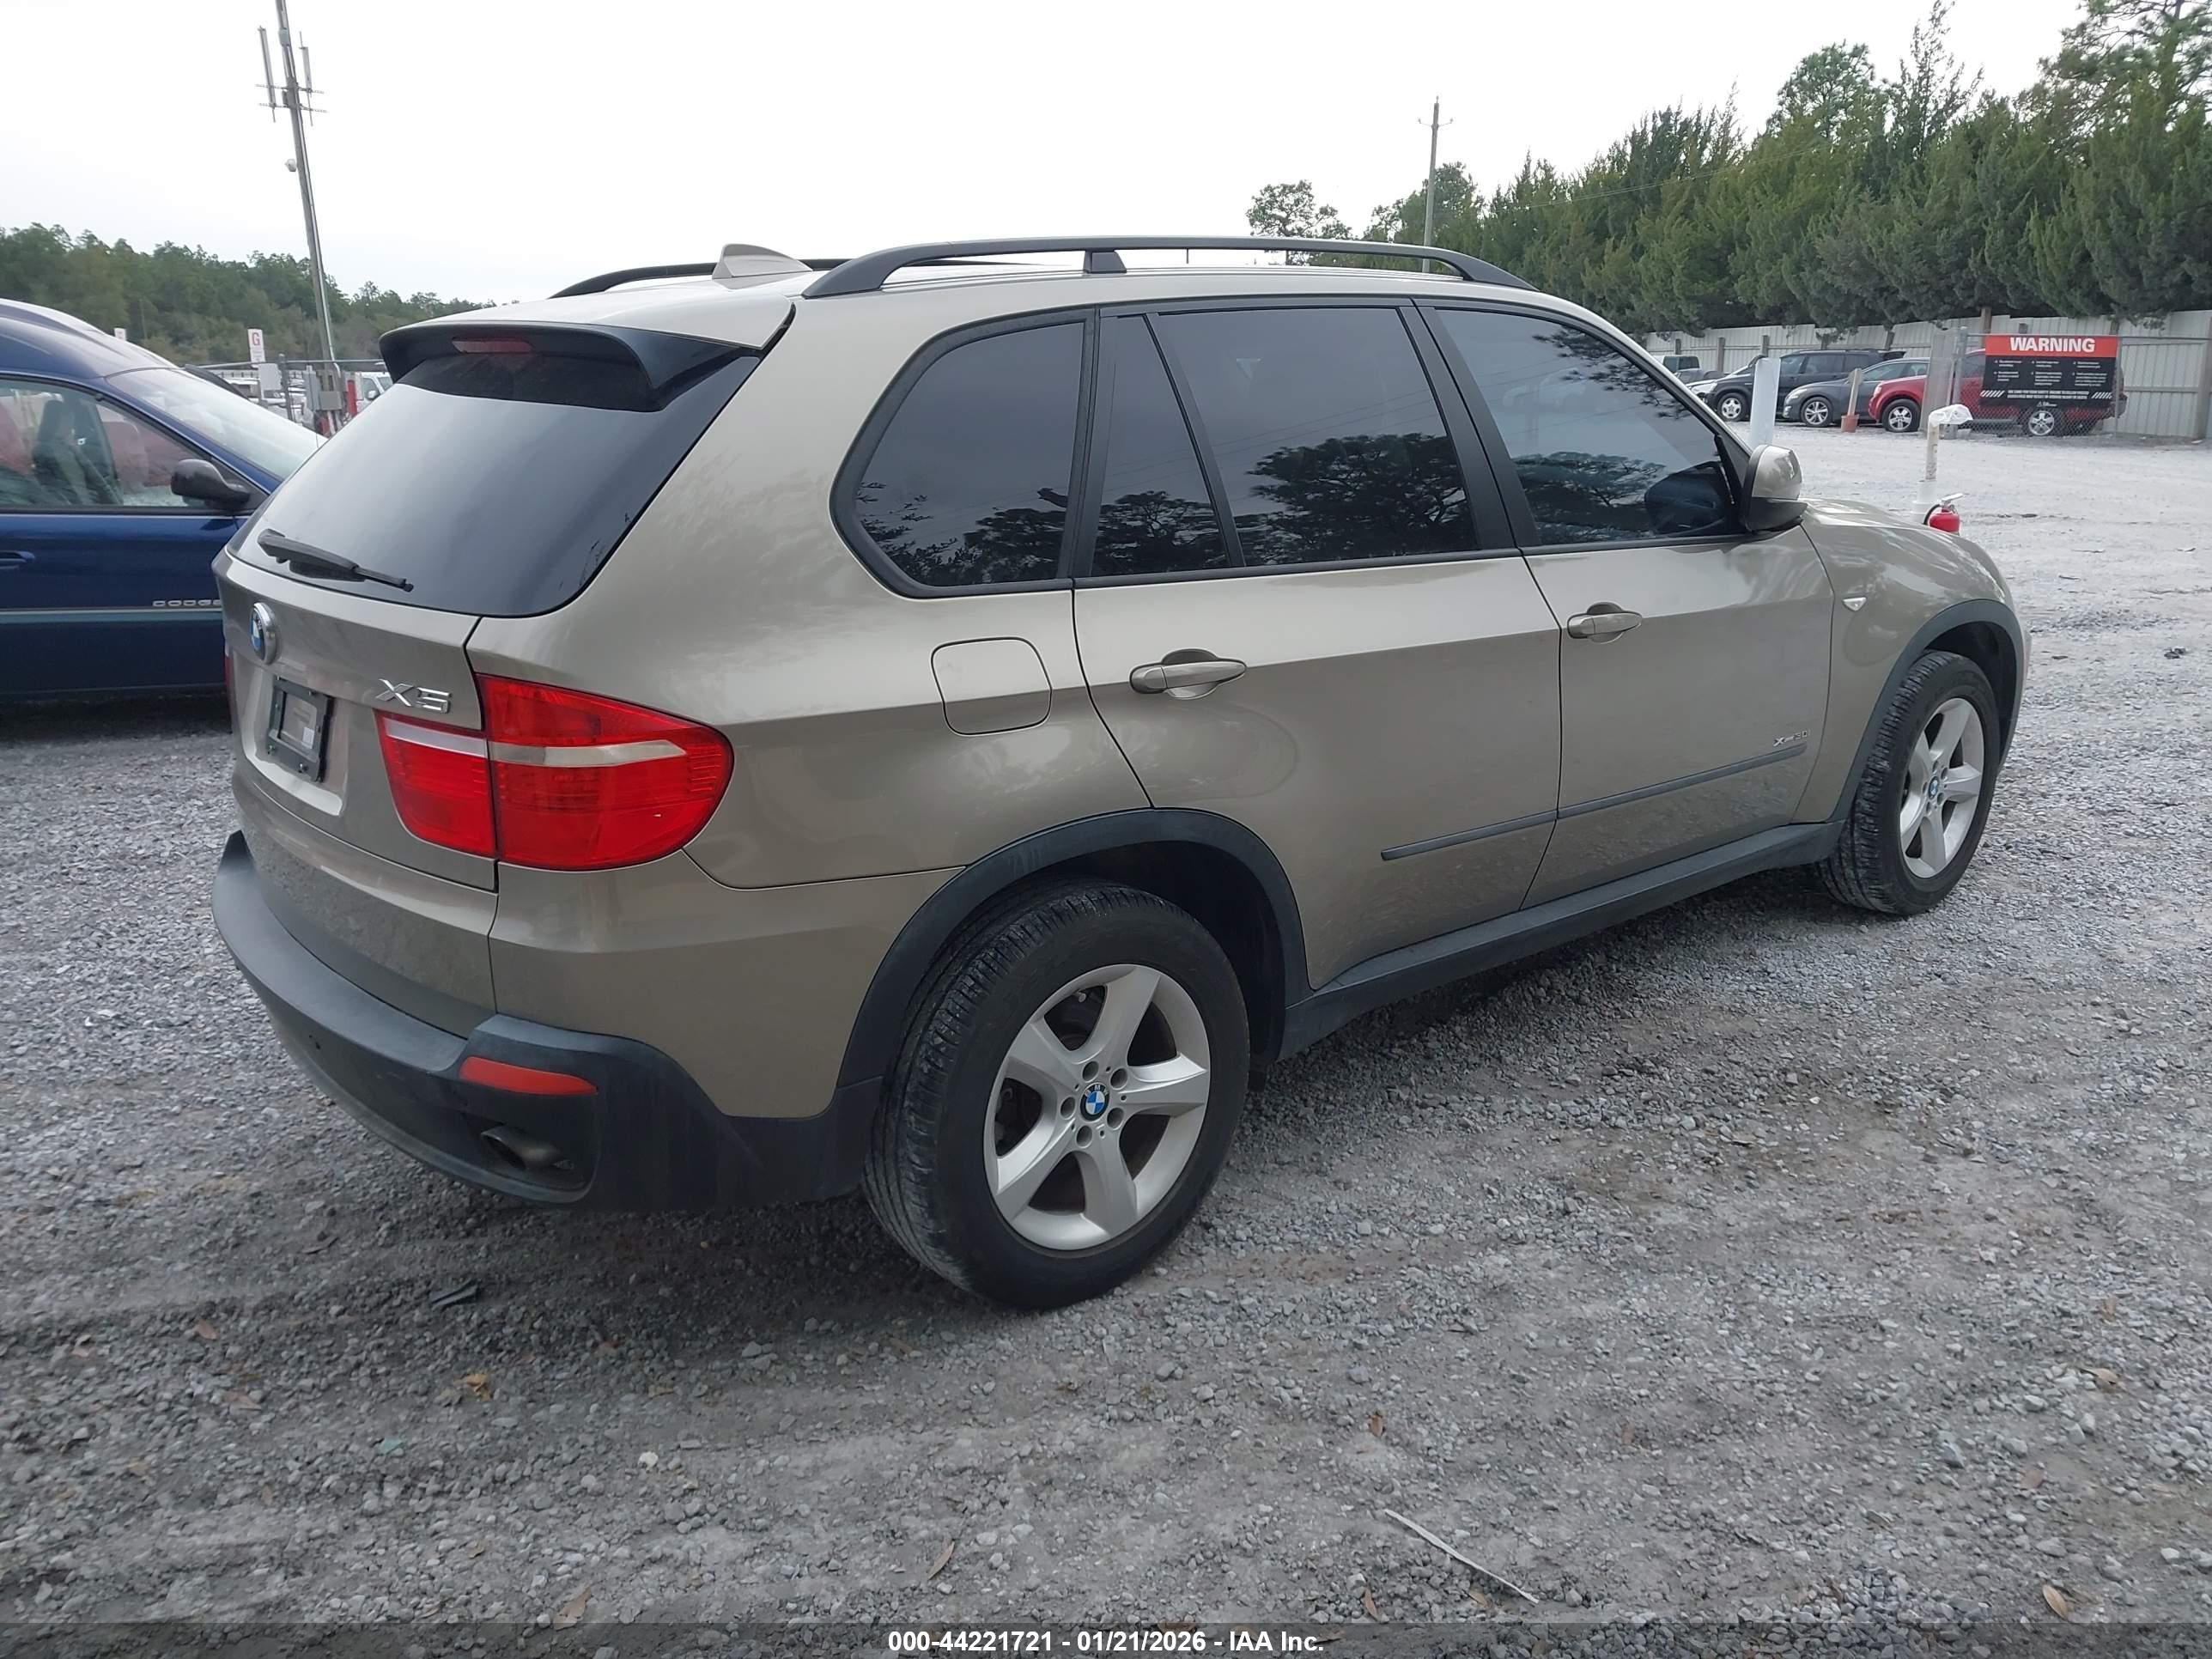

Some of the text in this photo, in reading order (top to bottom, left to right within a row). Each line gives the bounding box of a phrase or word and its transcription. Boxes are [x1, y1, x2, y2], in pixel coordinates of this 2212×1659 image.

[252, 331, 260, 346] G
[2010, 337, 2095, 353] WARNING
[375, 678, 451, 714] X5
